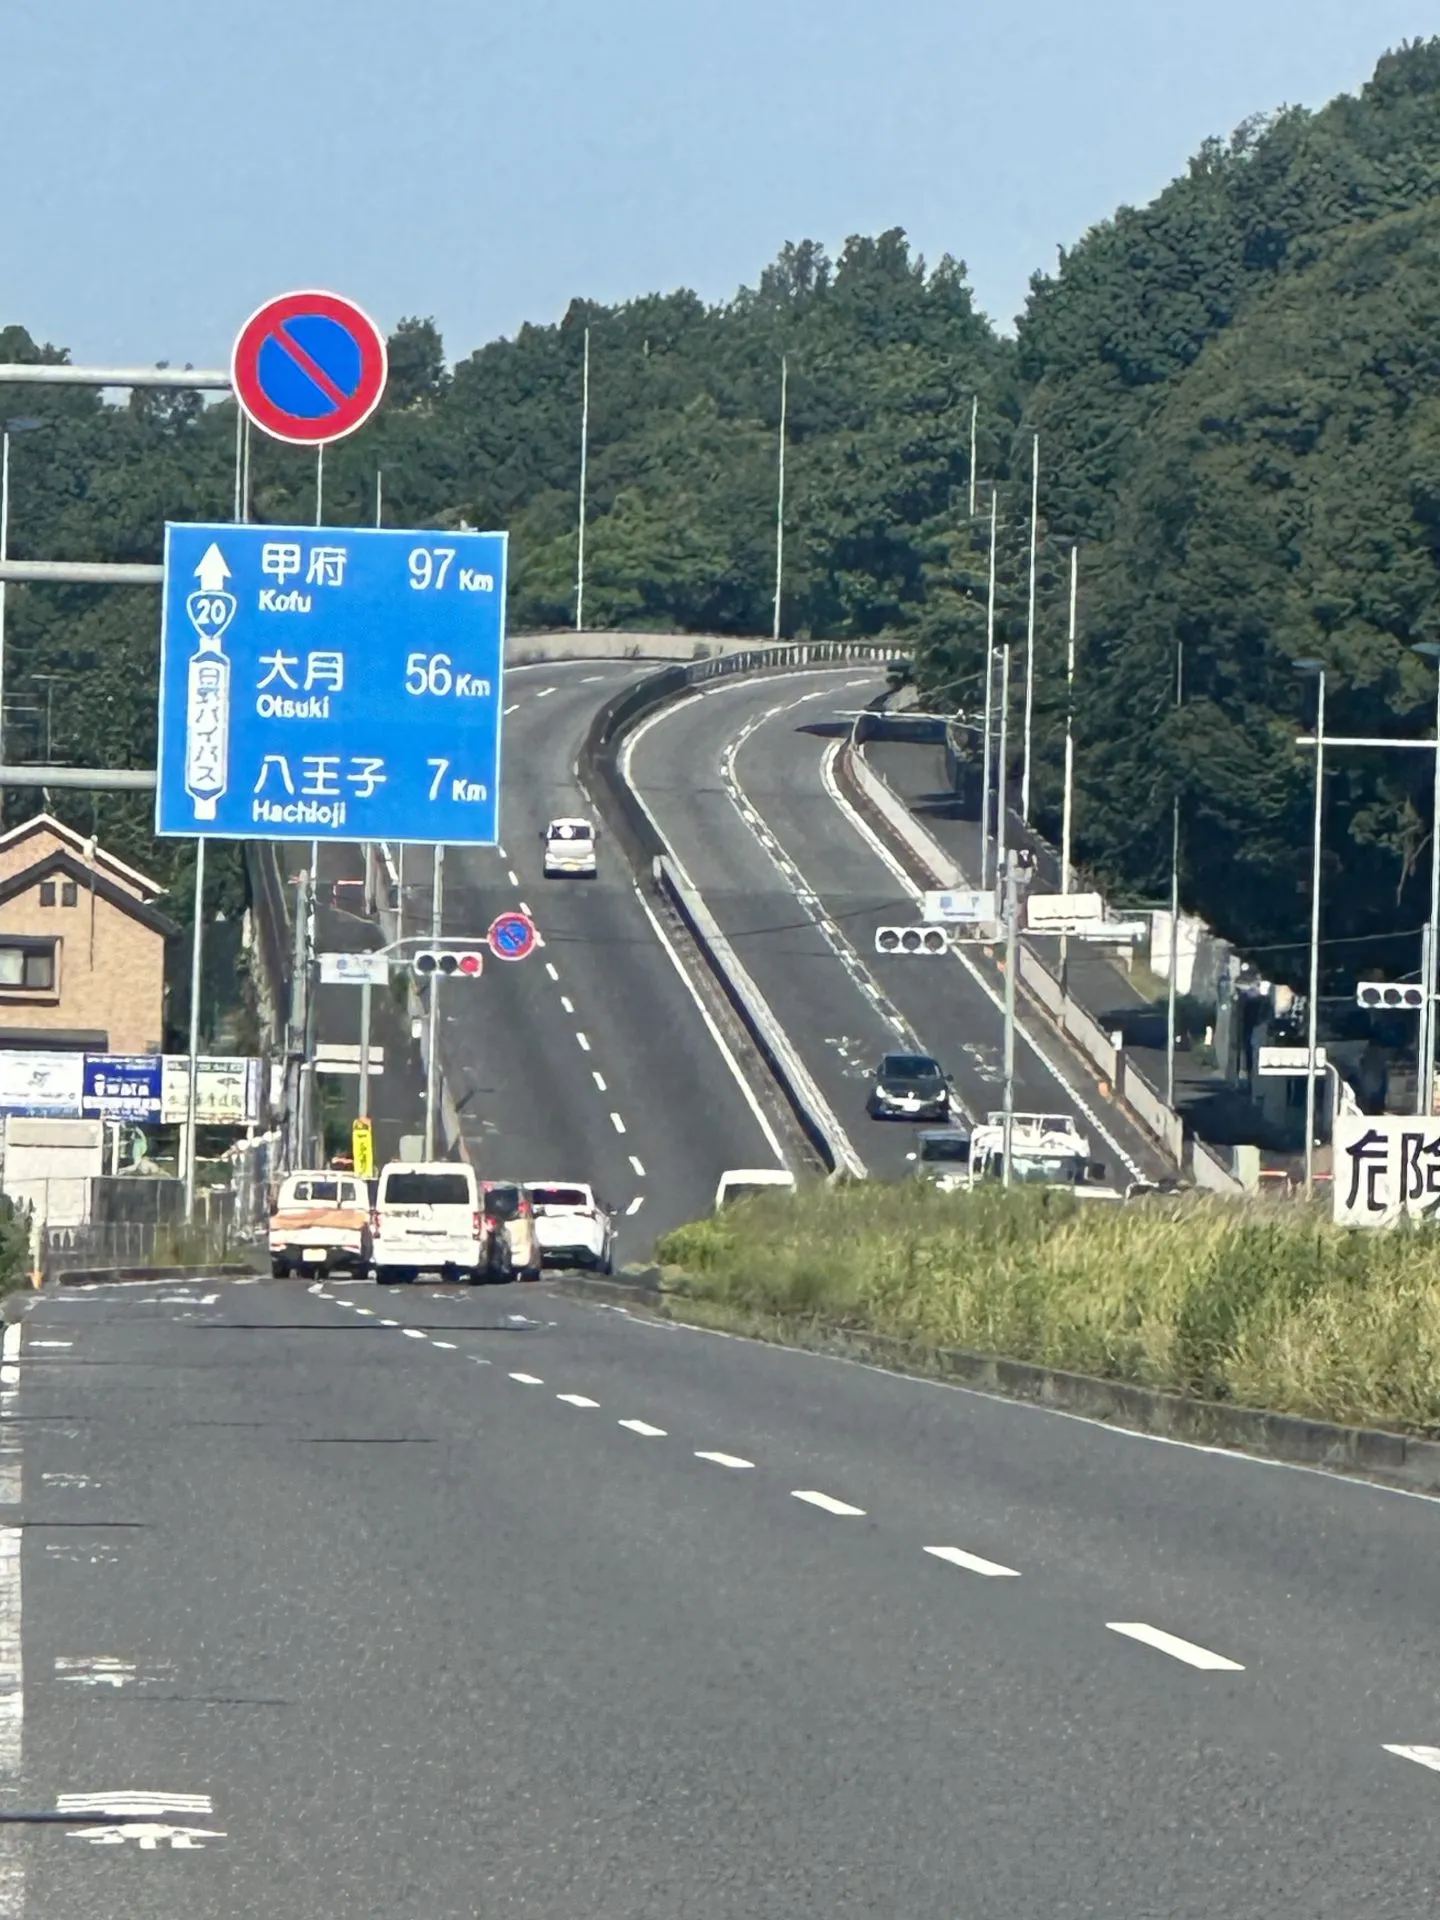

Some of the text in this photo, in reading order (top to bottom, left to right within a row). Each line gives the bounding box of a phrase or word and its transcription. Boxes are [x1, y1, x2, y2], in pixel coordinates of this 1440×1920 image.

[262, 543, 347, 585] 甲府
[408, 548, 493, 592] 97 Km
[196, 599, 226, 625] 20
[258, 589, 311, 612] Kofu
[256, 649, 343, 691] 大月
[405, 653, 491, 696] 56 Km
[256, 694, 329, 718] Otsuki
[254, 755, 387, 797] 八王子
[427, 758, 487, 801] 7 Km
[252, 799, 346, 828] Hachioji
